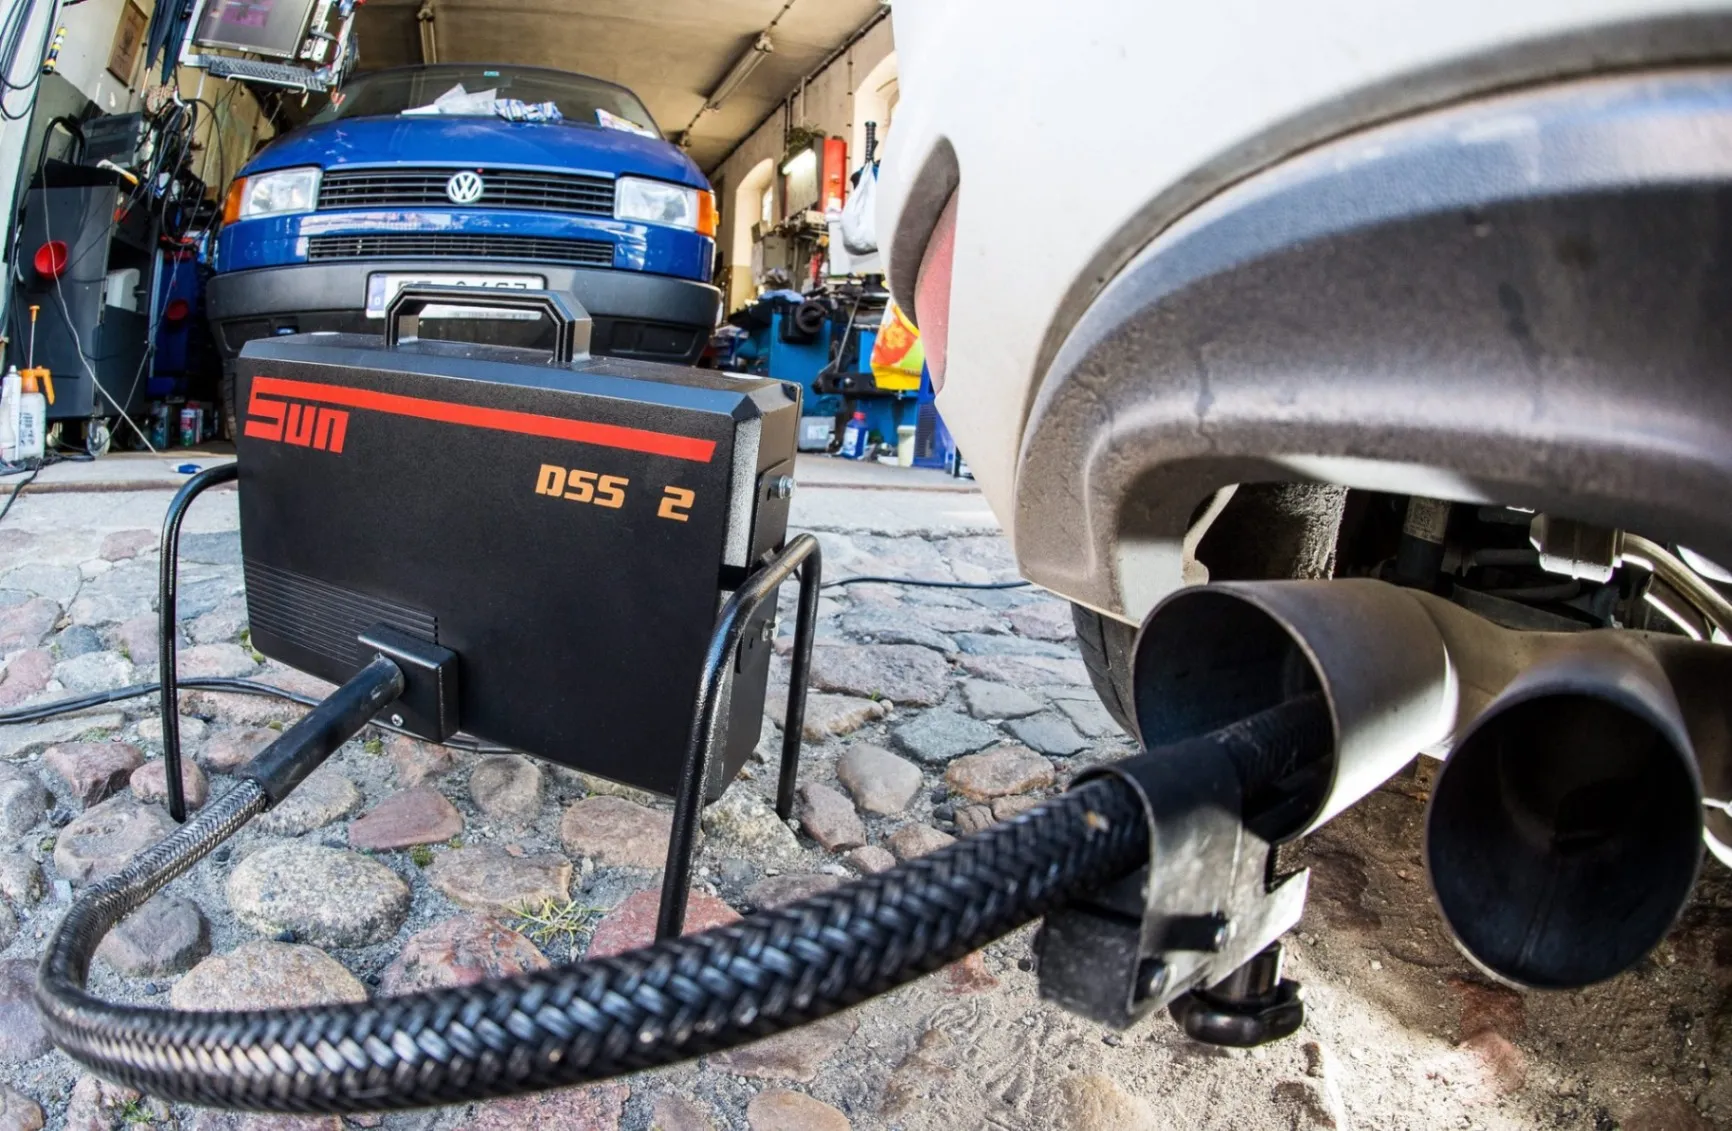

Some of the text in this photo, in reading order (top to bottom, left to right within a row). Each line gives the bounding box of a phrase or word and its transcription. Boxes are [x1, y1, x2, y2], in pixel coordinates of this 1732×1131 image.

[446, 171, 483, 203] VW
[535, 463, 696, 522] DSS 2
